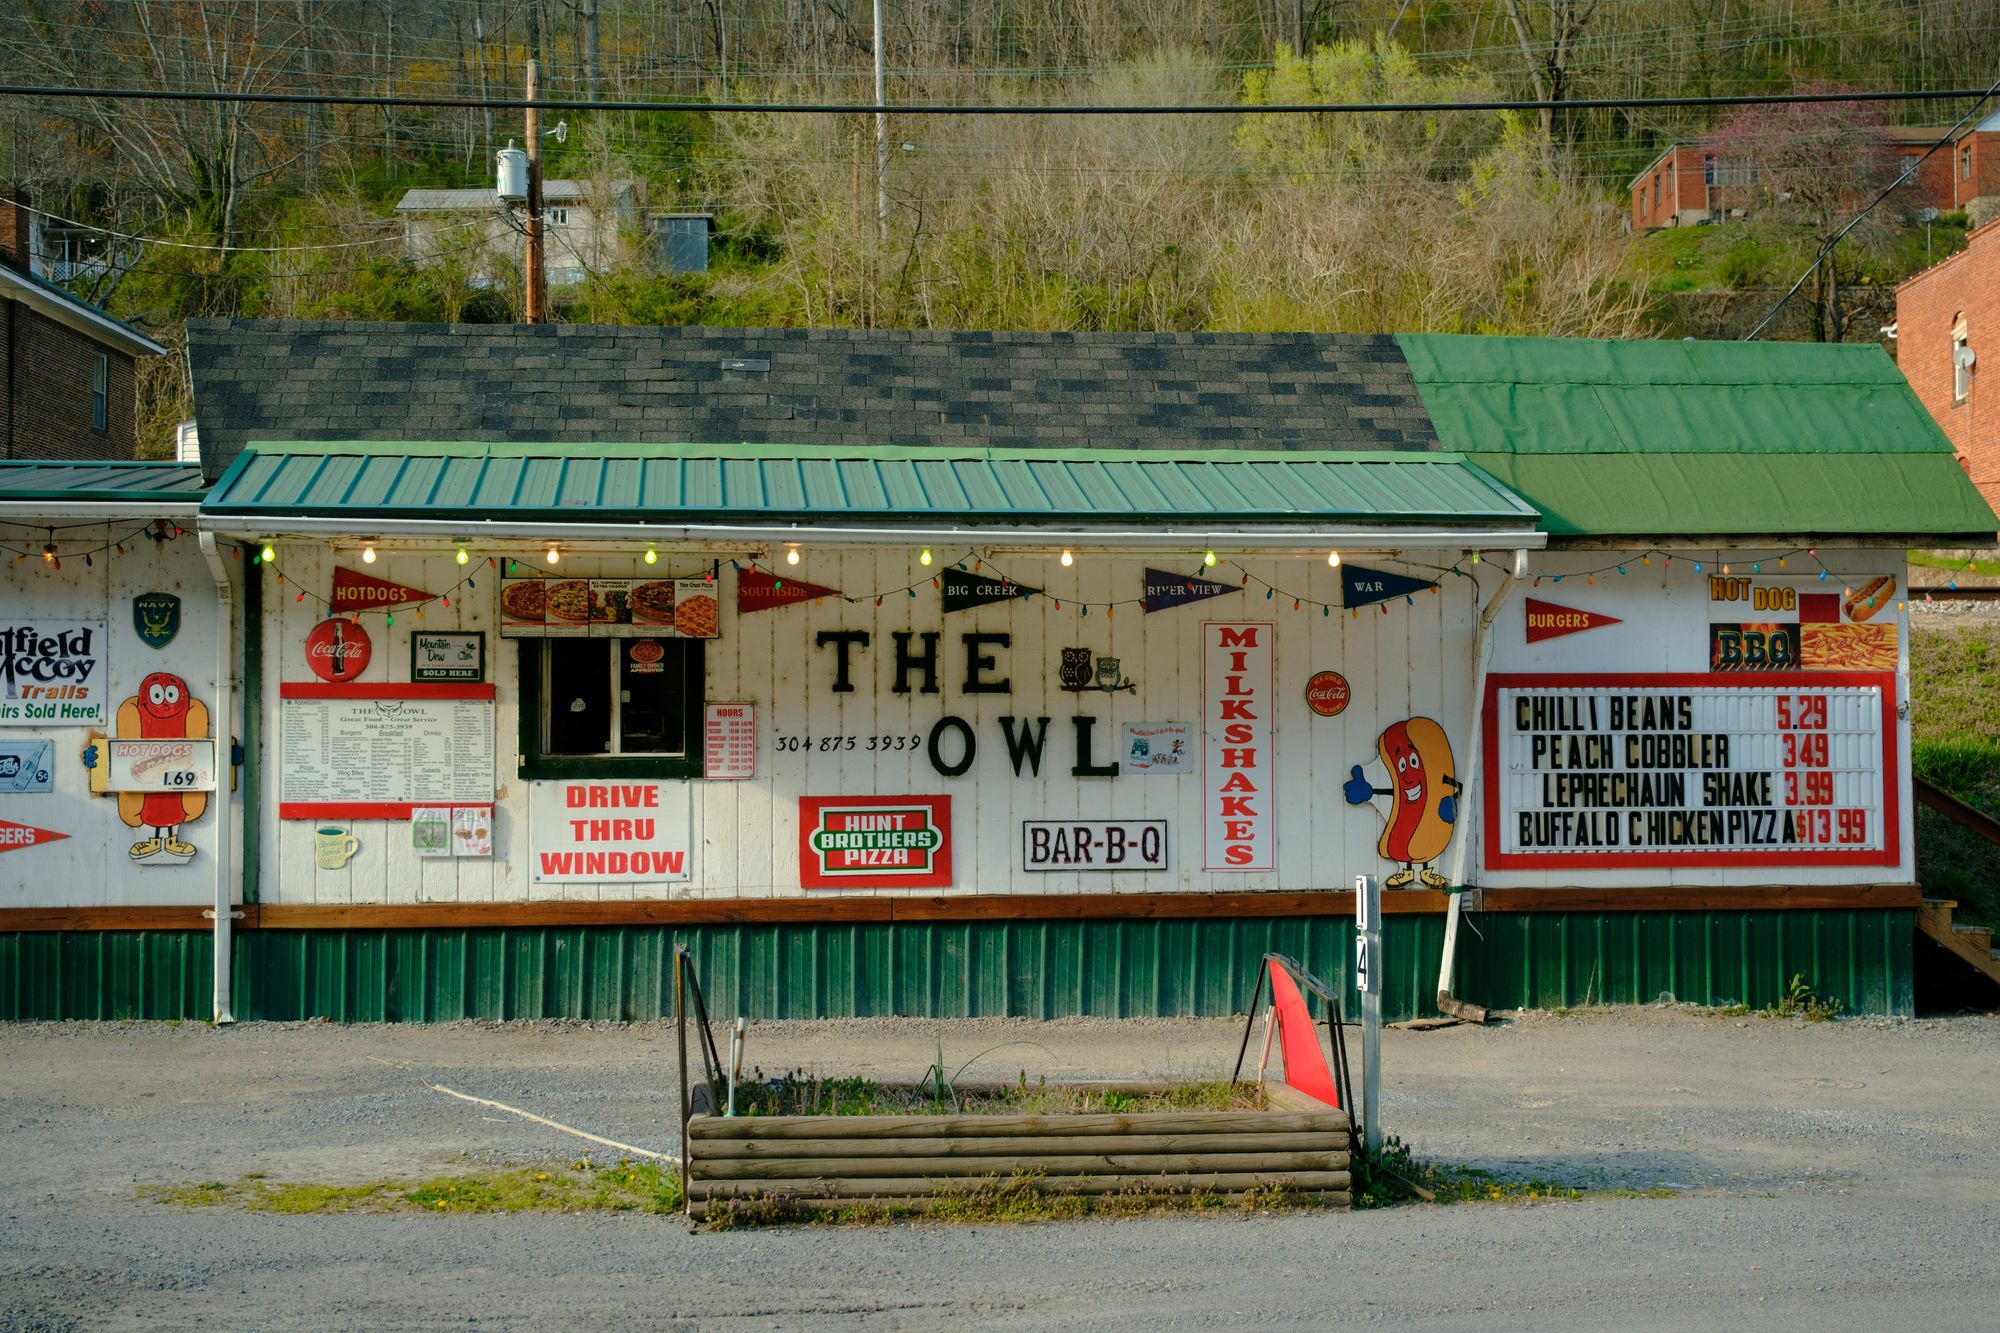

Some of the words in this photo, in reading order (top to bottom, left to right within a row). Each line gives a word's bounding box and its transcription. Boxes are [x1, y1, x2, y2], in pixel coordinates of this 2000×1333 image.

[337, 586, 408, 601] HOTDOGS
[741, 586, 808, 597] SOUTHSIDE
[947, 585, 969, 596] BIG
[976, 585, 1017, 596] CREEK
[1147, 585, 1186, 597] RIVER
[1189, 584, 1222, 595] VIEW
[1354, 581, 1384, 592] WAR
[1711, 577, 1752, 601] HOT
[1754, 587, 1796, 611] DOG
[1528, 613, 1589, 628] BURGERS
[311, 641, 365, 658] Coca-Cola
[419, 637, 451, 650] Mountain
[1718, 630, 1792, 665] BBQ
[427, 648, 445, 661] Dew
[816, 632, 1010, 694] THE
[21, 685, 89, 699] Trails
[1310, 687, 1346, 700] Coca-Cola
[0, 703, 19, 718] irs
[25, 703, 56, 718] Sold
[61, 703, 100, 718] Here!
[717, 709, 743, 717] HOURS
[1610, 696, 1692, 730] BEANS
[1777, 695, 1827, 730] 5.29
[776, 736, 812, 751] 304
[819, 736, 856, 751] 875
[866, 735, 920, 751] 3939
[928, 716, 1119, 777] OWL
[1217, 627, 1260, 866] MILKSHAKES
[1532, 734, 1613, 769] PEACH
[1625, 734, 1729, 768] COBBLER
[1783, 733, 1829, 768] 349
[163, 772, 195, 786] 1.69
[566, 785, 659, 808] DRIVE
[1543, 772, 1685, 807] LEPRECHAUN
[1703, 771, 1771, 807] SHAKE
[570, 818, 655, 842] THRU
[845, 814, 906, 832] HUNT
[1519, 811, 1619, 847] BUFFALO
[821, 832, 931, 848] BROTHERS
[1030, 827, 1160, 864] BAR-B-Q
[540, 851, 684, 875] WINDOW
[844, 848, 908, 865] PIZZA
